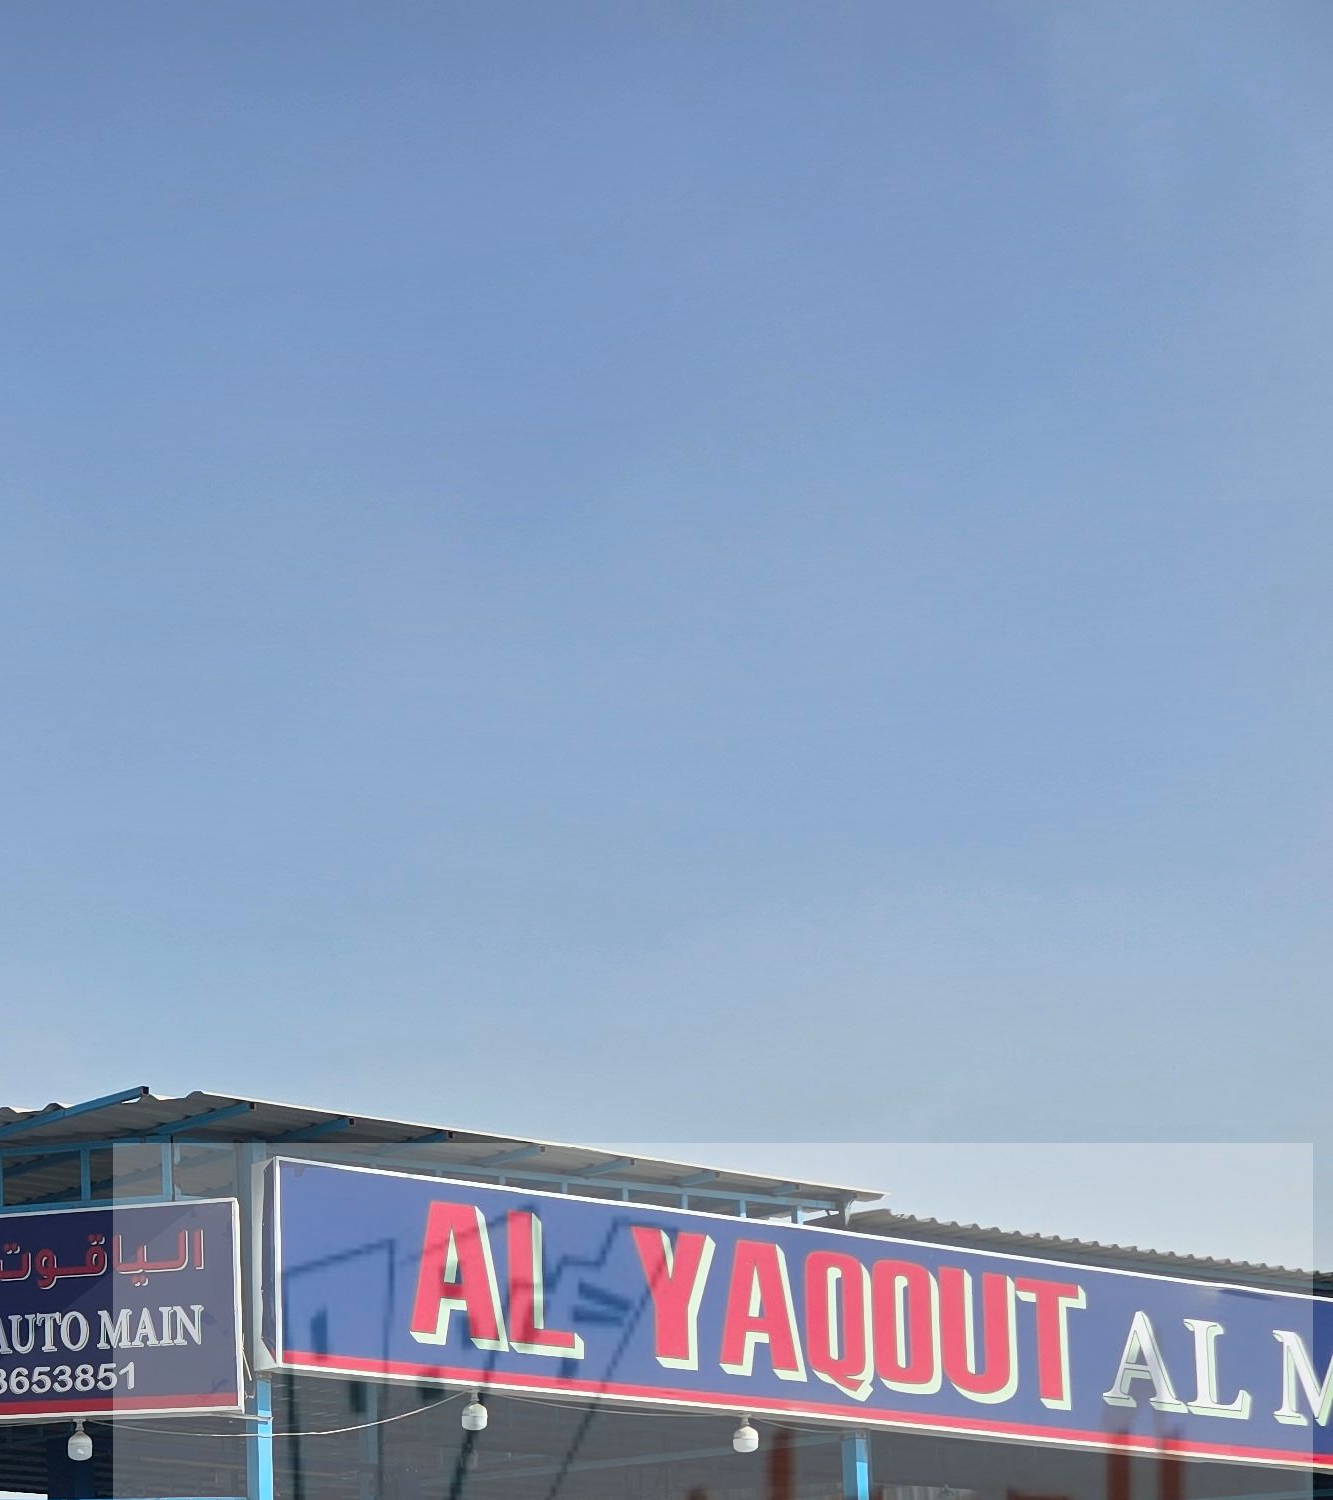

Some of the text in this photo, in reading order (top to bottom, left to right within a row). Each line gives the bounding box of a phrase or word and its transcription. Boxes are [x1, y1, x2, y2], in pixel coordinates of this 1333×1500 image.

[96, 1304, 205, 1351] MAIN
[410, 1199, 585, 1360] AL
[630, 1225, 1087, 1411] YAQOUT
[1101, 1309, 1252, 1420] AL
